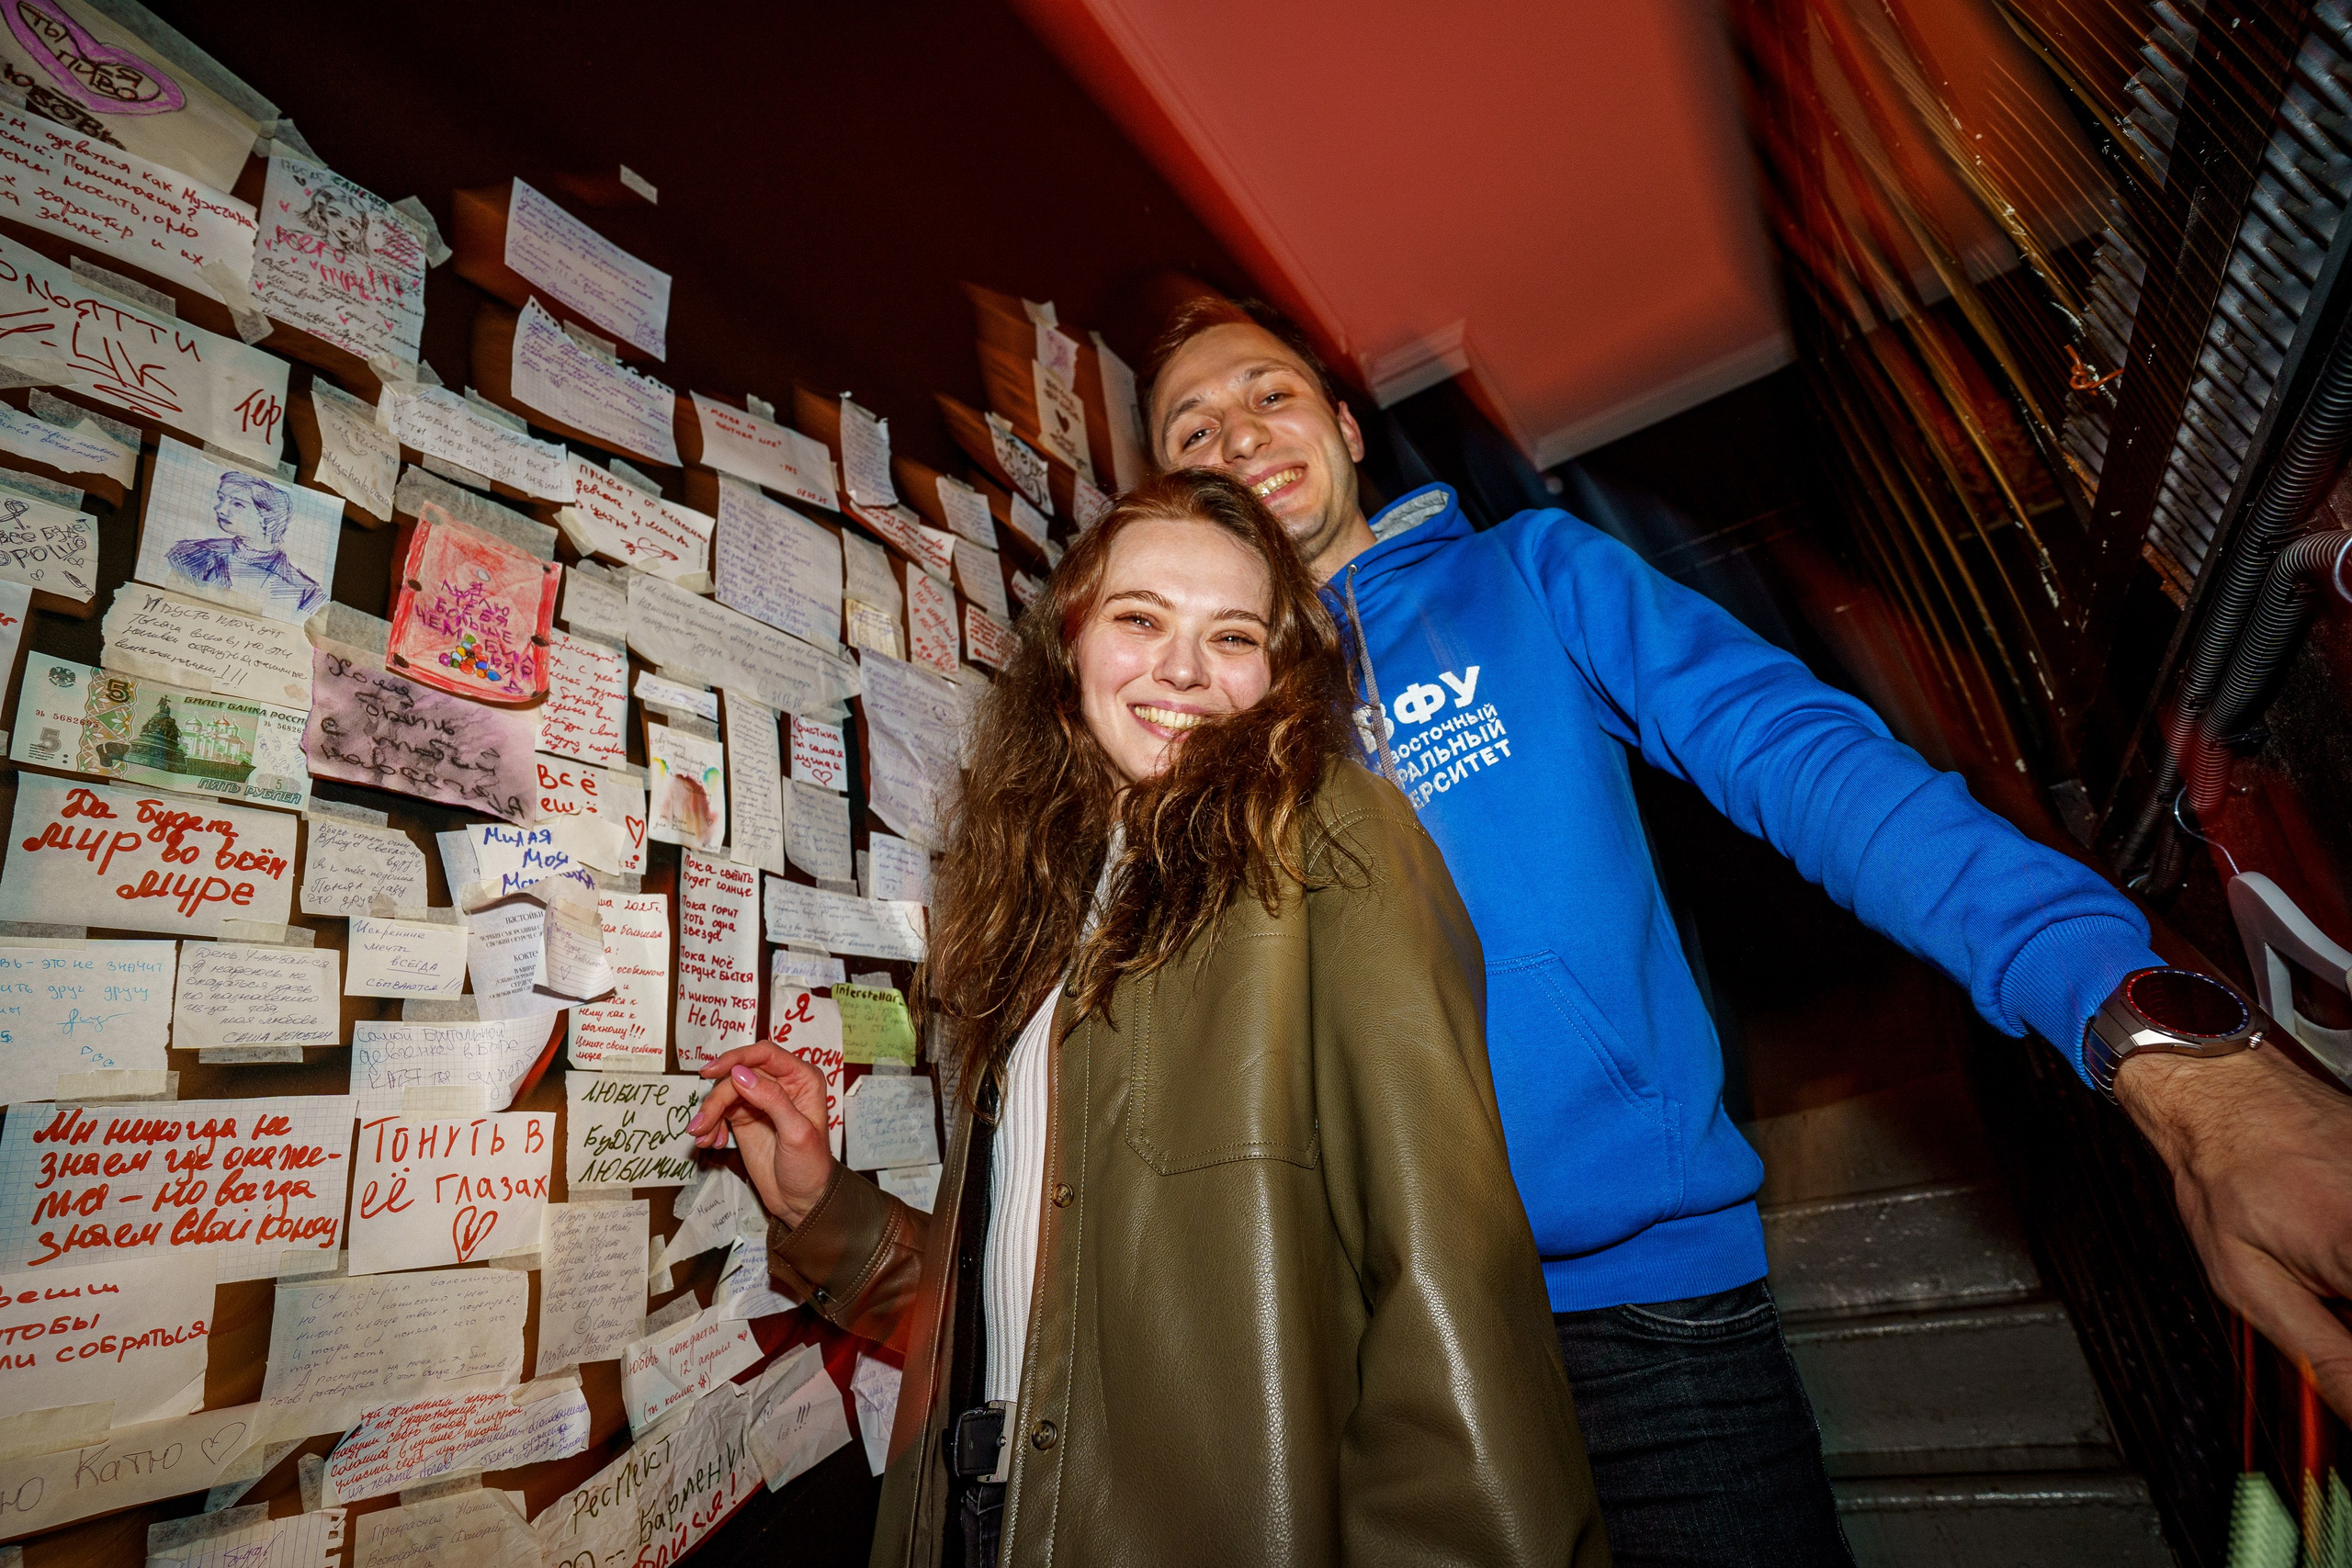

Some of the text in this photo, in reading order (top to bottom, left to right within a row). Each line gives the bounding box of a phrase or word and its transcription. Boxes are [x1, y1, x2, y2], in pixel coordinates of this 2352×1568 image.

[142, 172, 172, 192] как
[184, 695, 226, 709] БИЛЕТ
[227, 702, 266, 717] БАНКА
[52, 712, 100, 729] 5682695
[198, 777, 302, 806] ПЯТЬ РУБЛЕЙ
[61, 788, 240, 843] Да будет
[684, 854, 717, 875] Пока
[681, 895, 707, 911] Пока
[683, 926, 723, 944] звезда
[680, 944, 707, 963] Пока
[48, 985, 148, 1002] друг другу
[251, 1114, 292, 1140] не
[363, 1115, 505, 1163] ТОНУТЬ
[35, 1150, 153, 1190] знаем
[360, 1167, 415, 1219] её
[28, 1222, 163, 1266] знаем
